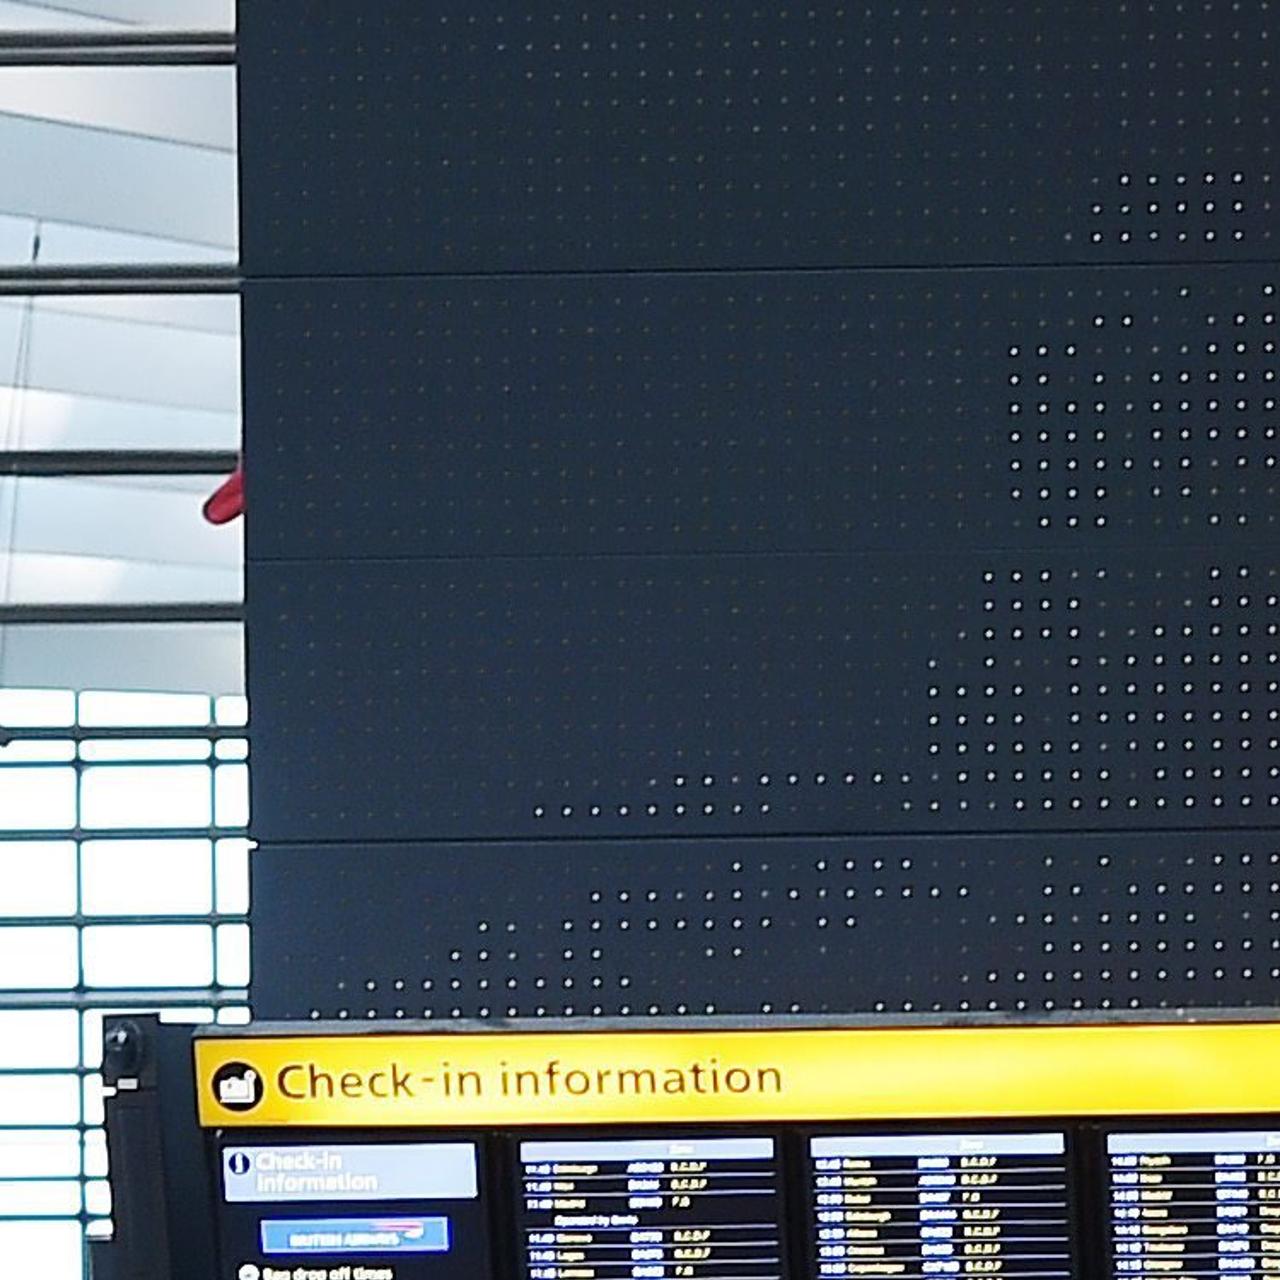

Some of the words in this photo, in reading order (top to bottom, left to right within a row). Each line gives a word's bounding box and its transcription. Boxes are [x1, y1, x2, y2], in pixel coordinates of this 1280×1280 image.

[276, 1063, 480, 1102] Check-in
[500, 1060, 783, 1096] information
[255, 1152, 342, 1171] Check-in
[256, 1173, 378, 1192] information
[329, 1267, 350, 1280] off
[353, 1267, 393, 1280] times
